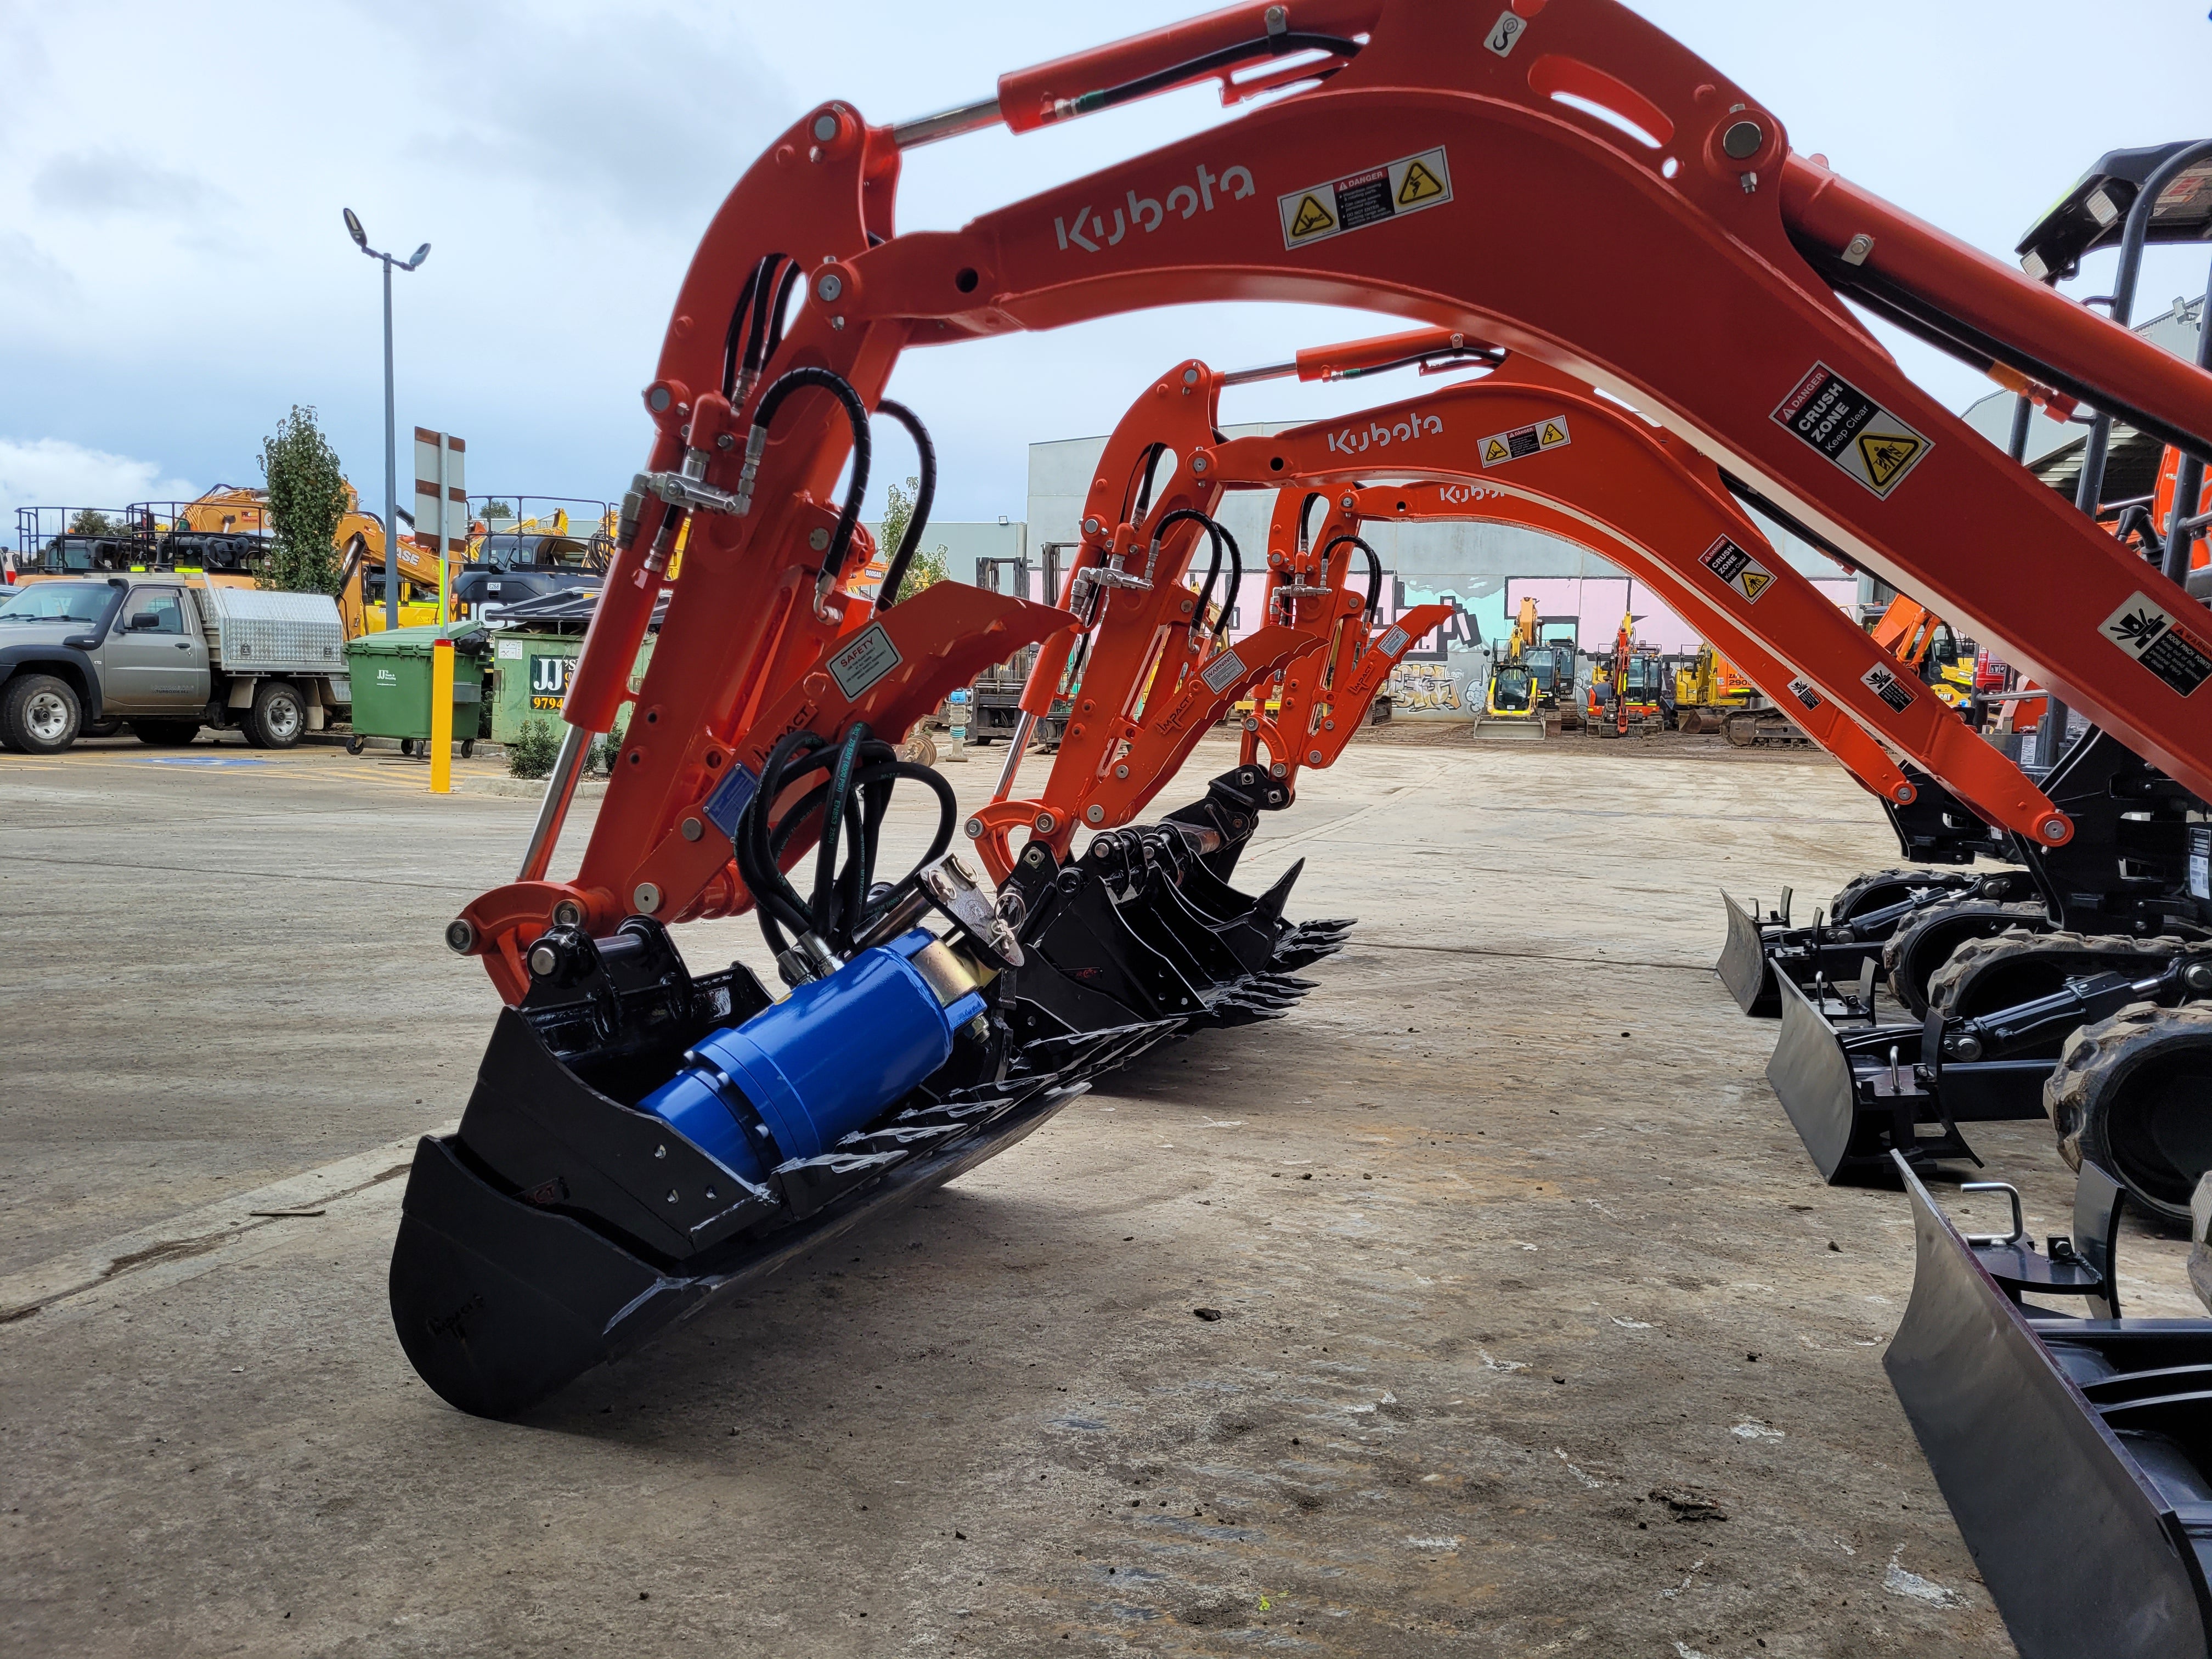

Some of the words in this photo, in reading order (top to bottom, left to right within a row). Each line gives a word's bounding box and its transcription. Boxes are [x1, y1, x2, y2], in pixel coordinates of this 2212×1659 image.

[1348, 171, 1383, 187] DANGER
[1054, 164, 1255, 253] Kubota
[1791, 373, 1825, 408] DANGER
[1798, 383, 1844, 431] CRUSH
[1328, 413, 1443, 454] Kubota
[1811, 402, 1850, 442] ZONE
[1825, 429, 1848, 452] Keep
[1846, 405, 1869, 429] Clear
[1440, 486, 1505, 504] Kubo
[397, 546, 420, 566] ASE
[1709, 539, 1726, 557] DANGER
[1712, 545, 1735, 568] CRUSH
[1718, 555, 1737, 574] ZONE
[1725, 568, 1736, 579] Keep
[1735, 557, 1747, 569] Clear
[461, 603, 516, 628] JC
[1381, 628, 1400, 648] WARNING
[2166, 633, 2181, 646] BOOM
[2180, 644, 2195, 656] PINCH
[2186, 633, 2212, 657] WARNIN
[840, 636, 874, 668] SAFETY
[2149, 650, 2170, 667] personal
[2170, 664, 2182, 676] injury
[2155, 645, 2166, 654] area
[2172, 657, 2183, 668] avoid
[2160, 640, 2172, 651] Keep
[2187, 659, 2196, 668] this
[1206, 654, 1233, 678] WARNING
[1156, 696, 1189, 731] IMPACT
[845, 748, 854, 759] BAR
[840, 761, 849, 778] (4000
[836, 778, 845, 793] PSI)
[831, 800, 840, 825] EN853
[828, 828, 836, 844] 2SN
